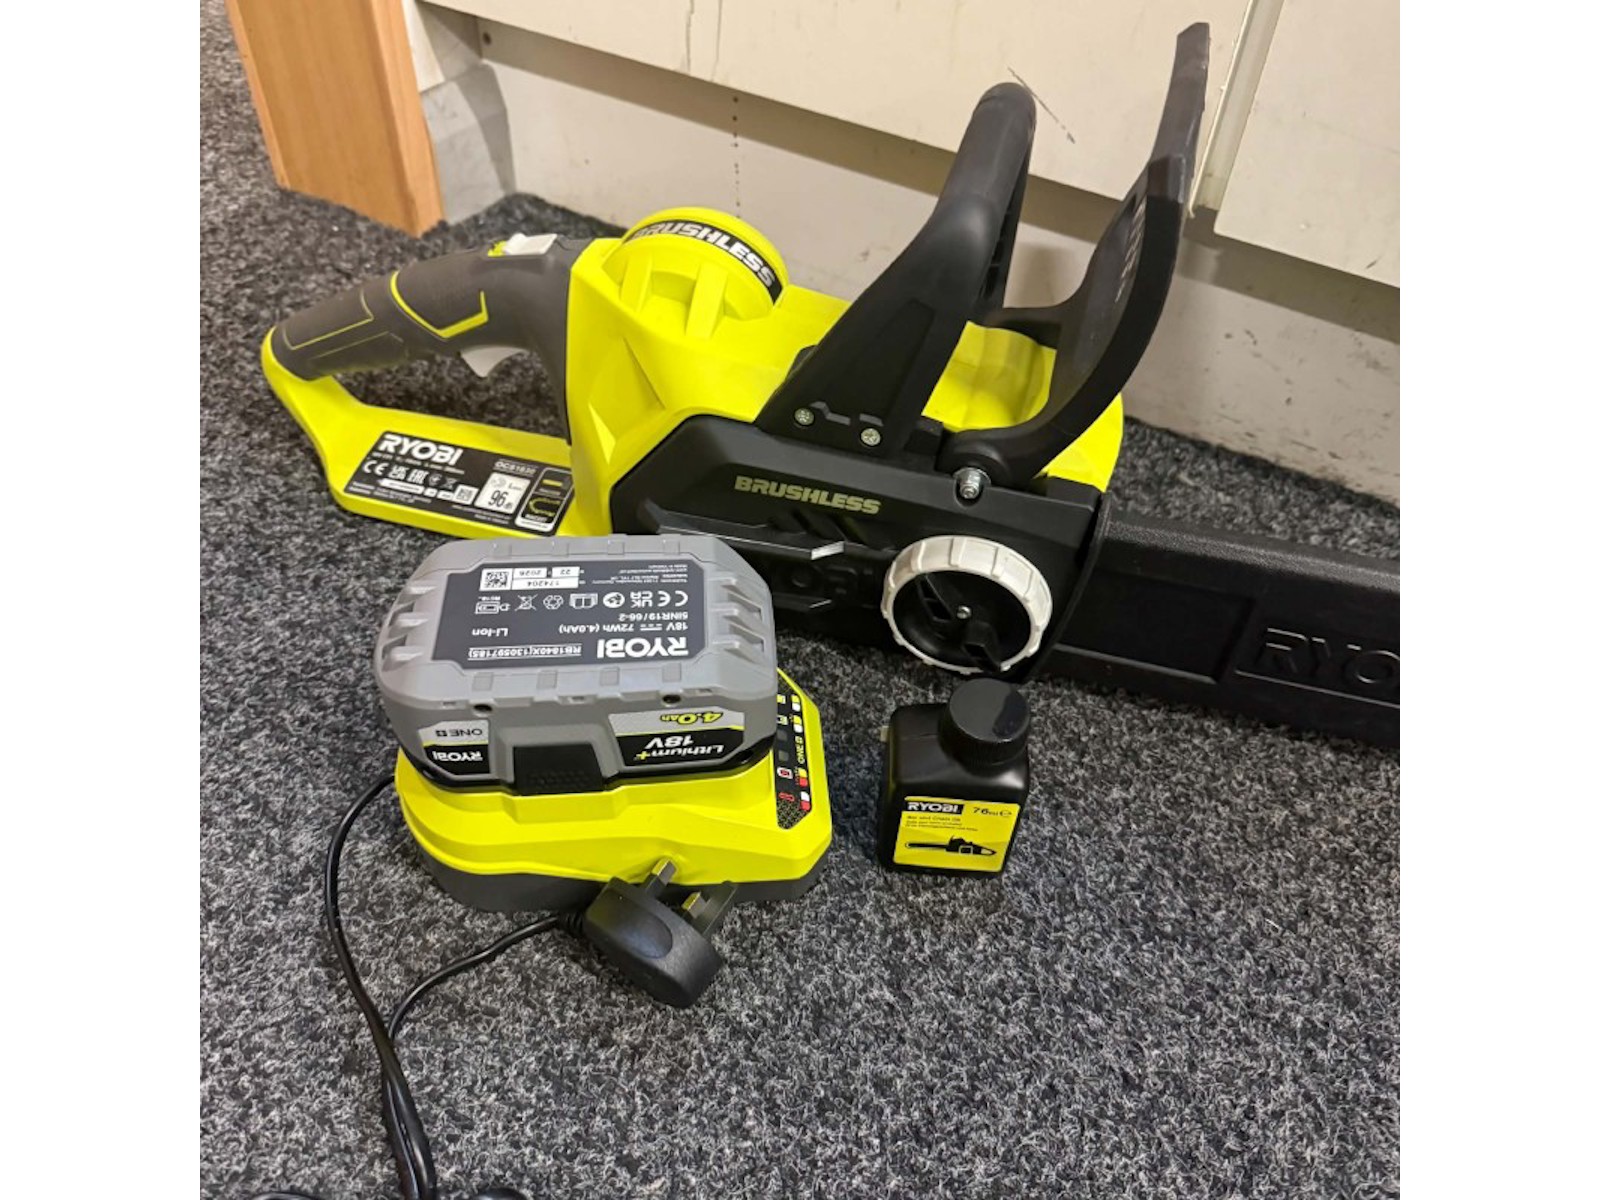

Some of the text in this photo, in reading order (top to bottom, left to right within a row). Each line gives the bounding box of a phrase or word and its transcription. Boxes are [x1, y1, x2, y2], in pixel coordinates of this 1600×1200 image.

[379, 434, 464, 465] RYOBI
[488, 490, 508, 507] 96
[734, 475, 882, 515] BRUSHLESS
[471, 627, 509, 637] Li-Ion
[559, 622, 688, 634] 18V 72Wh (4.0Ah)
[597, 637, 689, 658] RYOBI
[660, 711, 723, 725] 4.0Ah
[645, 735, 694, 749] 18V
[432, 751, 483, 762] RYOBI
[907, 802, 959, 813] RYOBI
